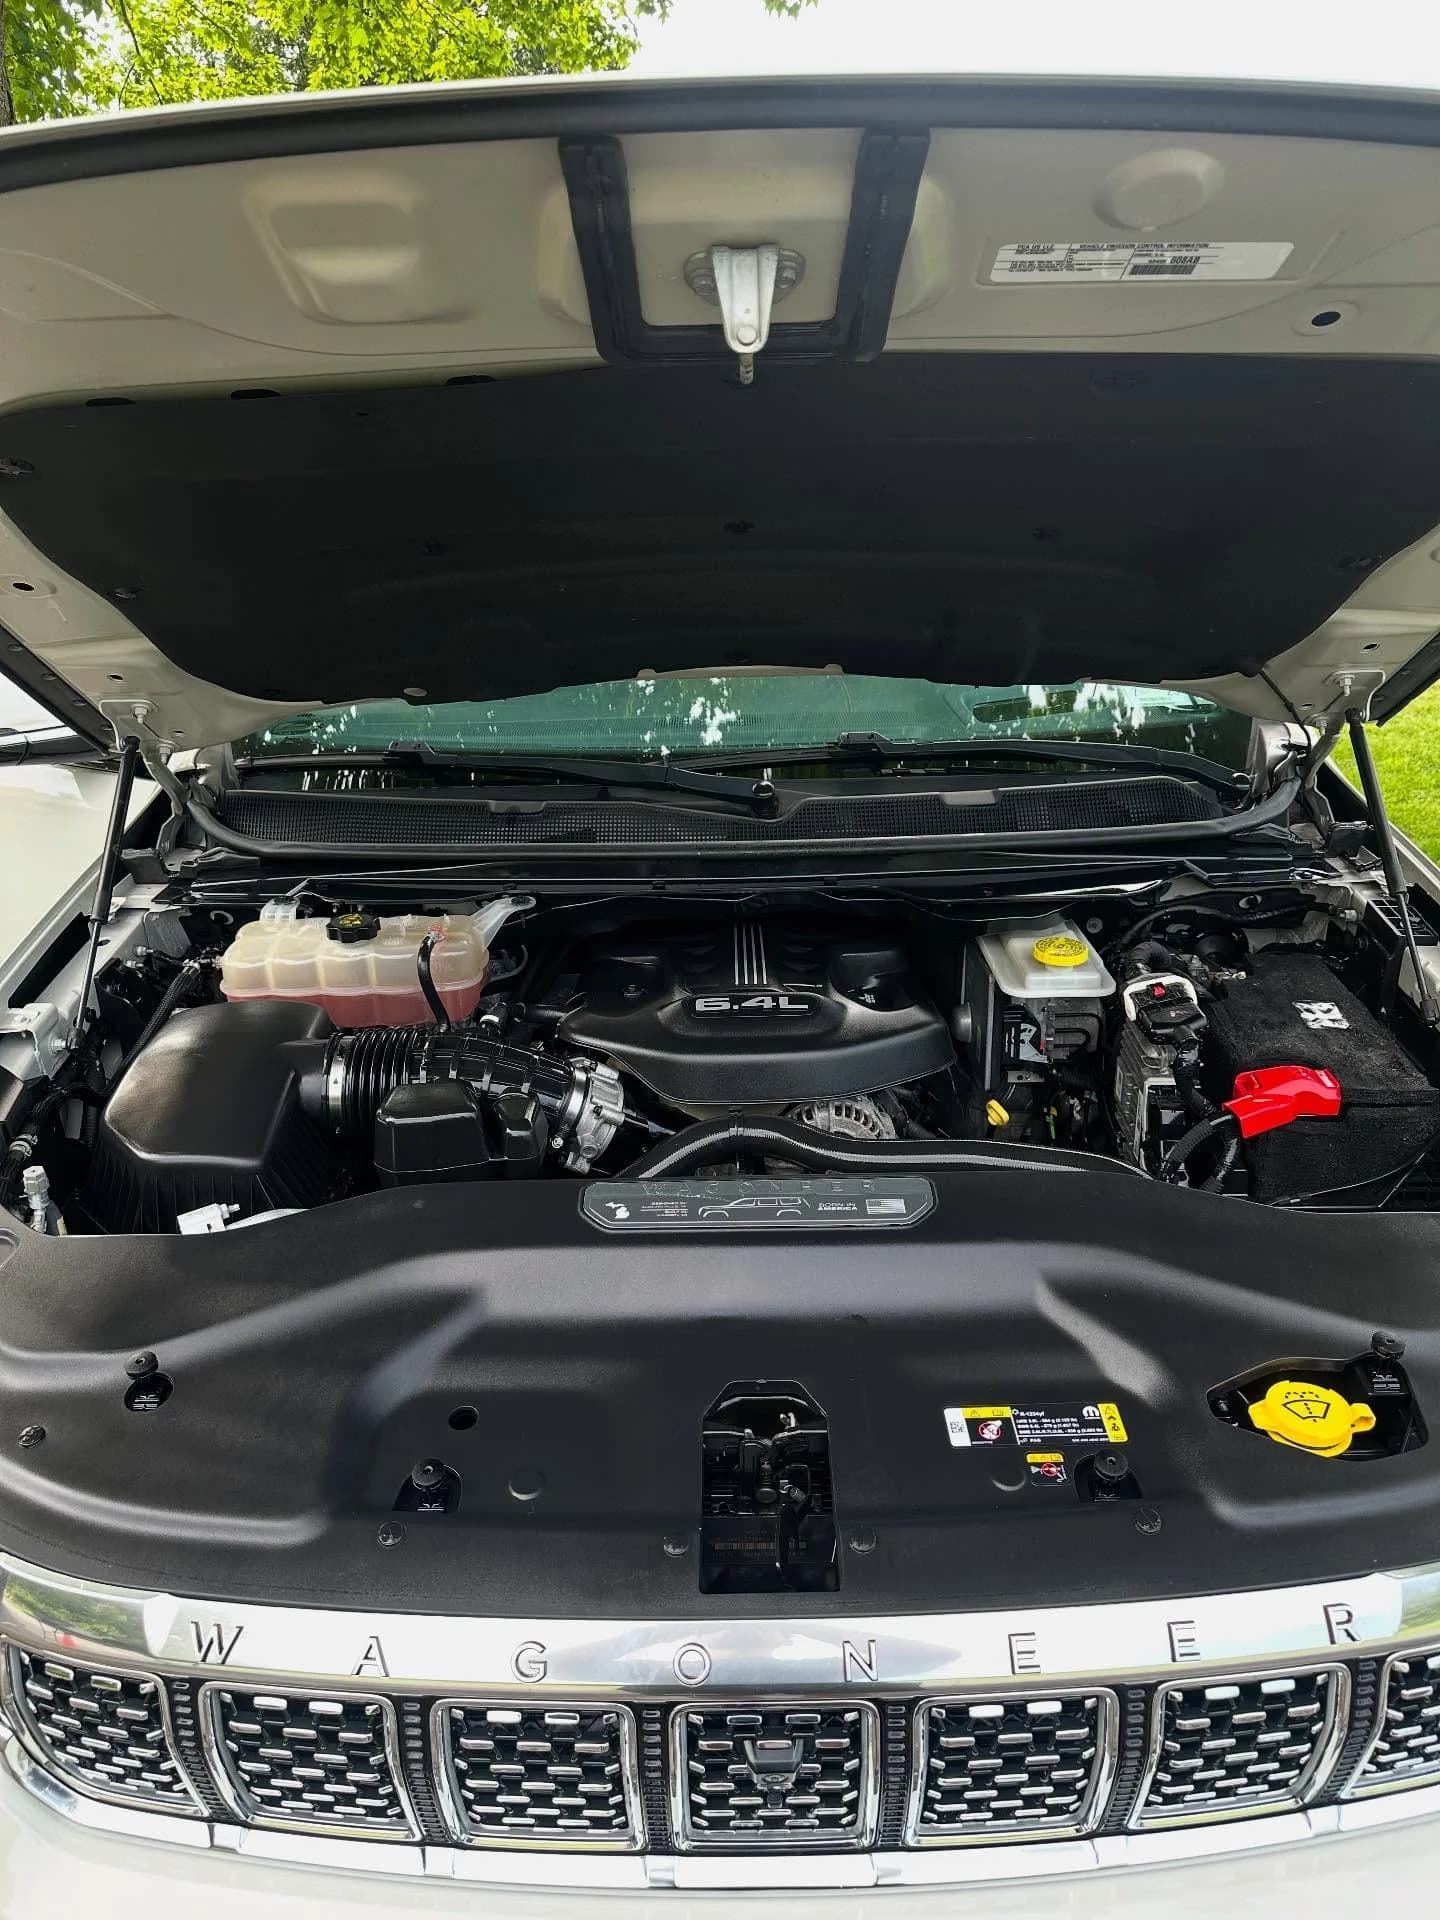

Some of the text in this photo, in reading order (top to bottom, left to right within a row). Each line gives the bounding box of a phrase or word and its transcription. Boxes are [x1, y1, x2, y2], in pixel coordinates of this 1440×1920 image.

[695, 996, 809, 1011] 6.4L
[642, 1180, 876, 1196] WAGONEER
[190, 1602, 1362, 1687] WAGONEER
